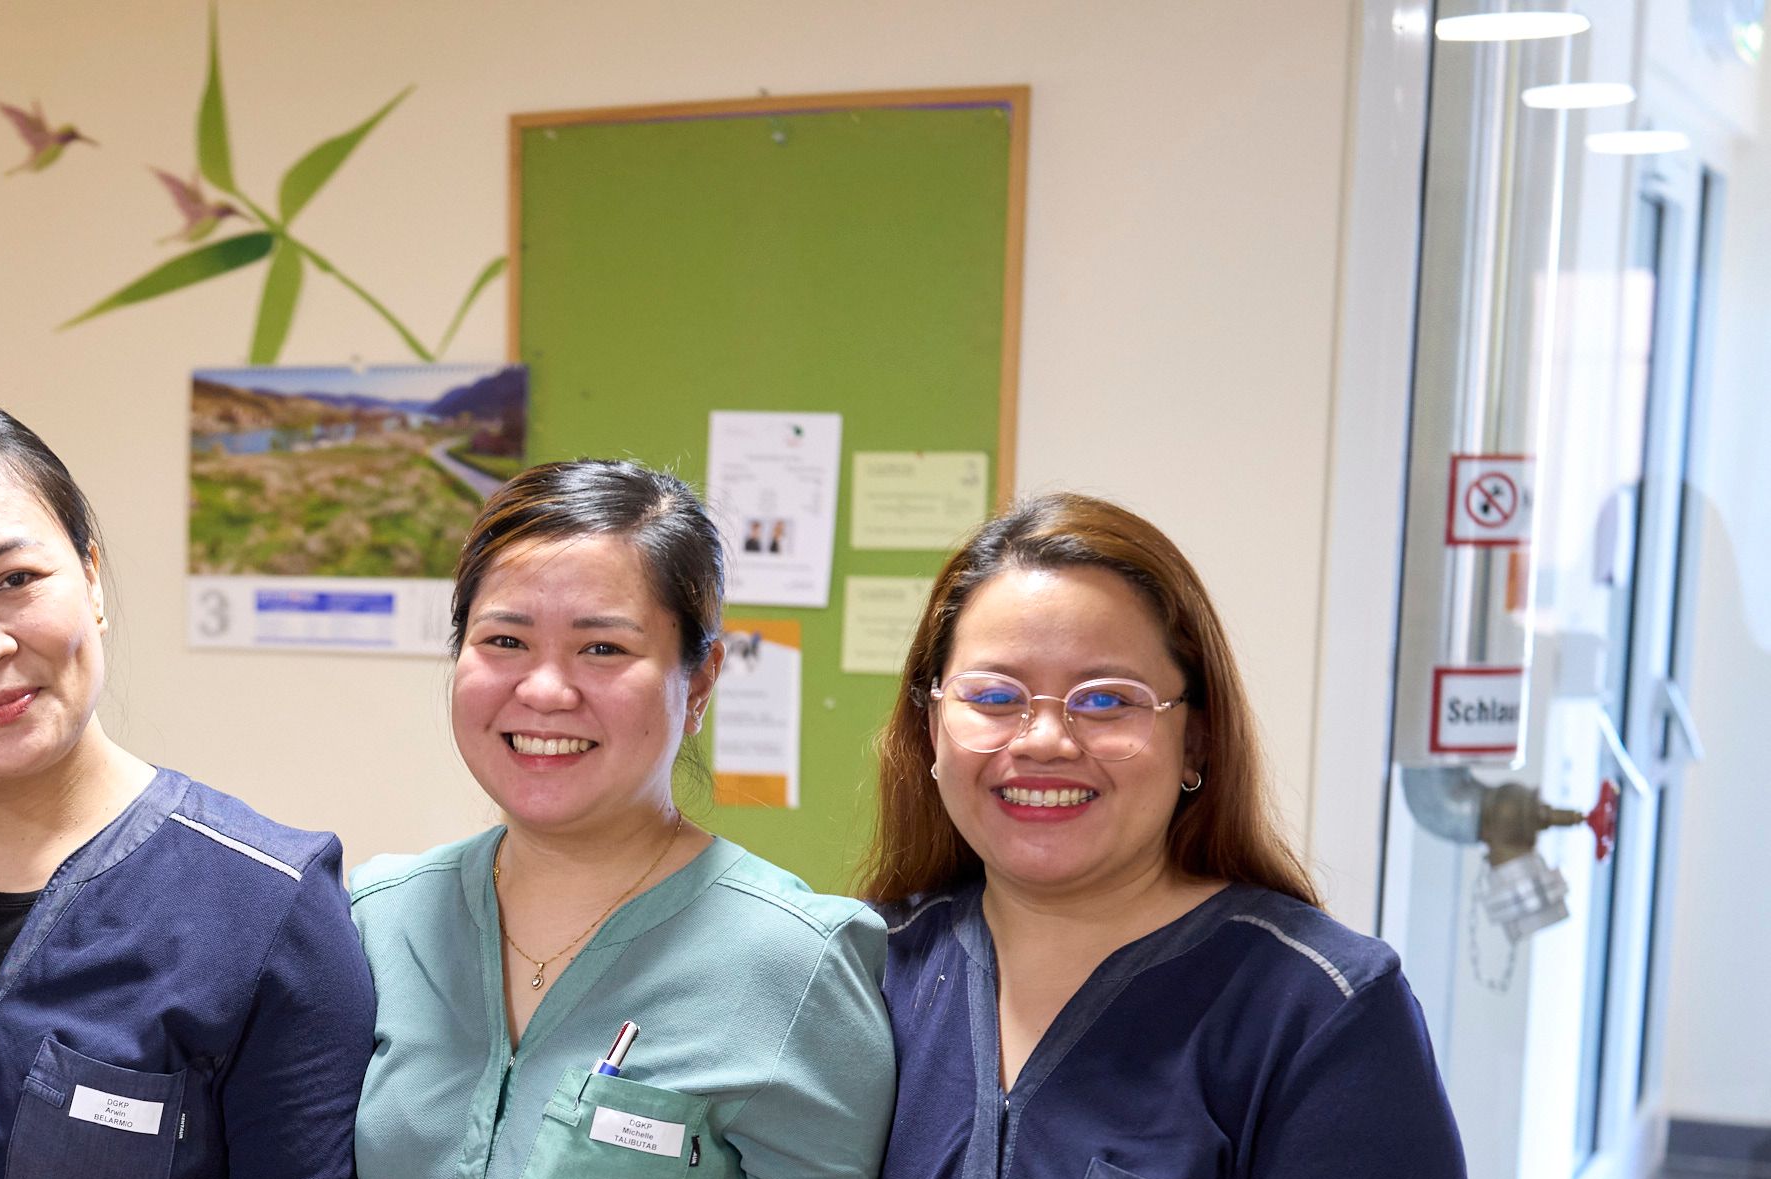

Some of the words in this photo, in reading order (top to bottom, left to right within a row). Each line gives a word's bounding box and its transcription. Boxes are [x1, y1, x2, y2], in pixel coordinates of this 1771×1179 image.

[199, 588, 229, 637] 3
[106, 1098, 129, 1108] DGKP
[105, 1107, 126, 1117] Arwin
[629, 1119, 653, 1129] DGKP
[622, 1127, 654, 1140] Michelle
[614, 1134, 658, 1151] TALIBUTAB
